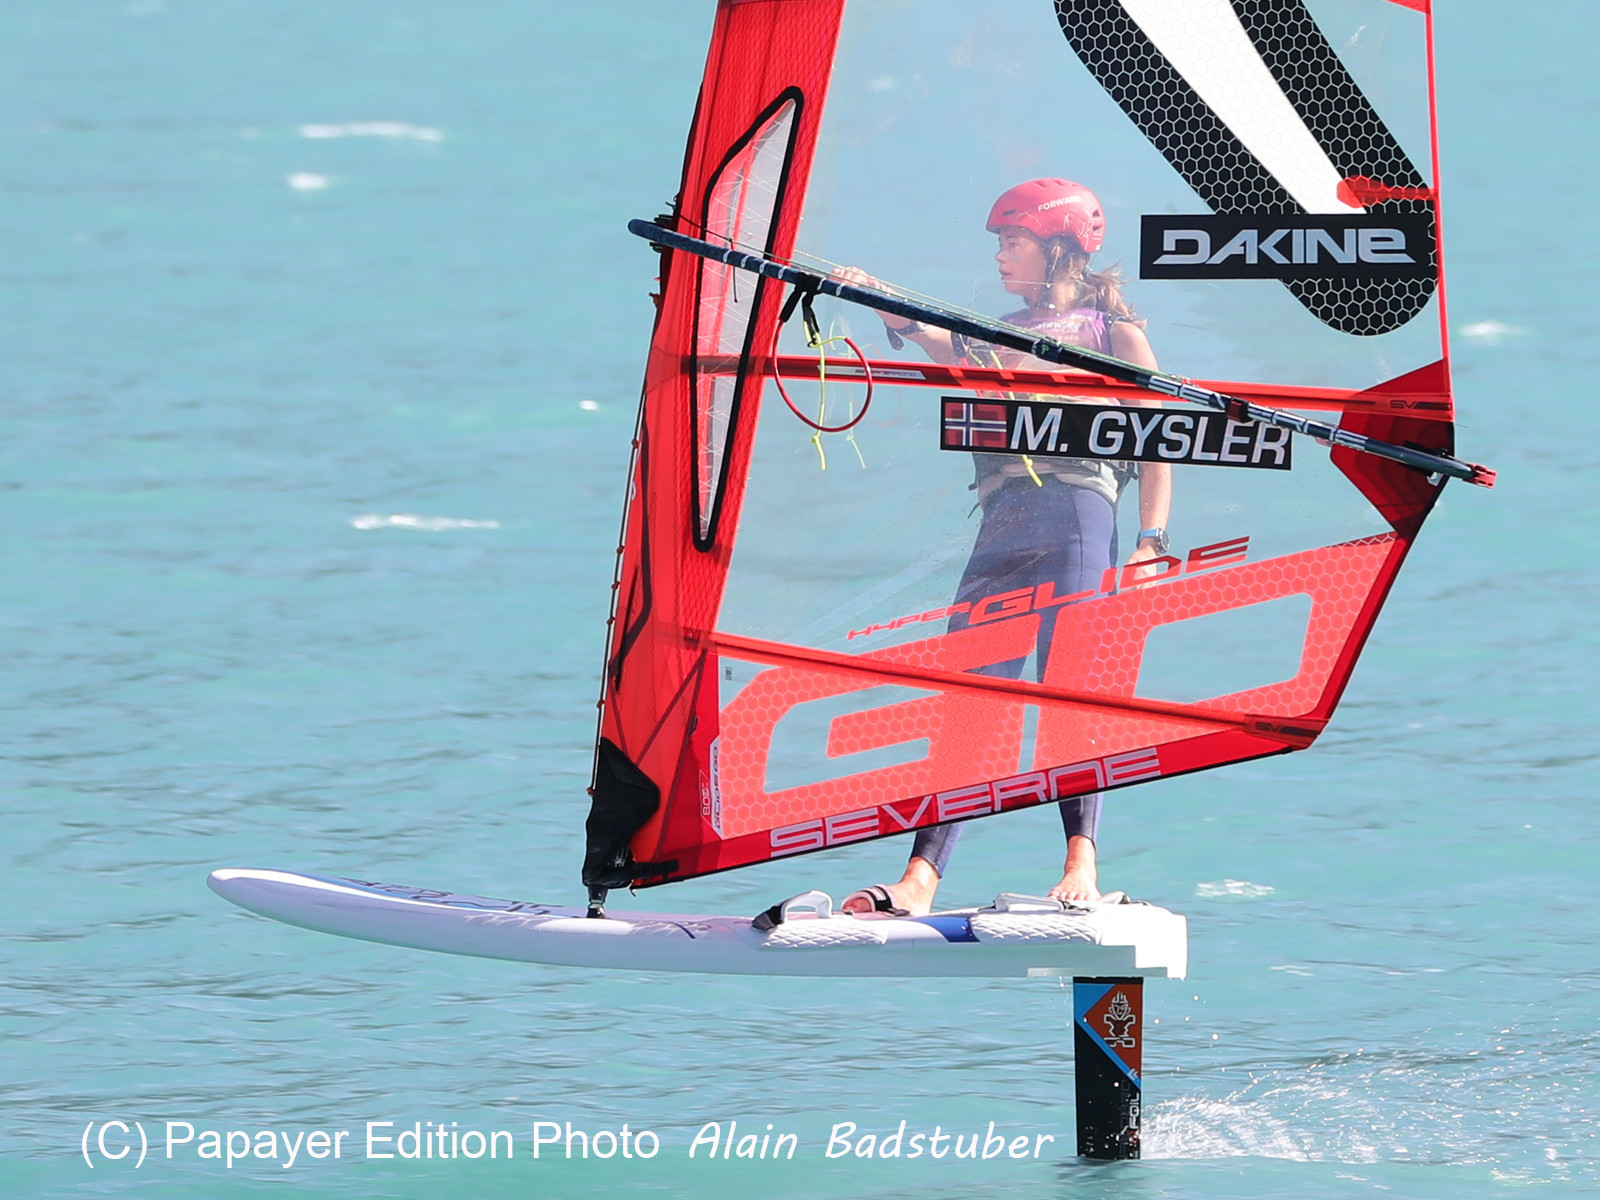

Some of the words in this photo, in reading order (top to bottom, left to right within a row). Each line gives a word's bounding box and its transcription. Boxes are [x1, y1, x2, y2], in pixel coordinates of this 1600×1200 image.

[1010, 405, 1068, 452] M.
[1087, 409, 1292, 465] GYSLER
[770, 747, 1162, 858] SEVERNE
